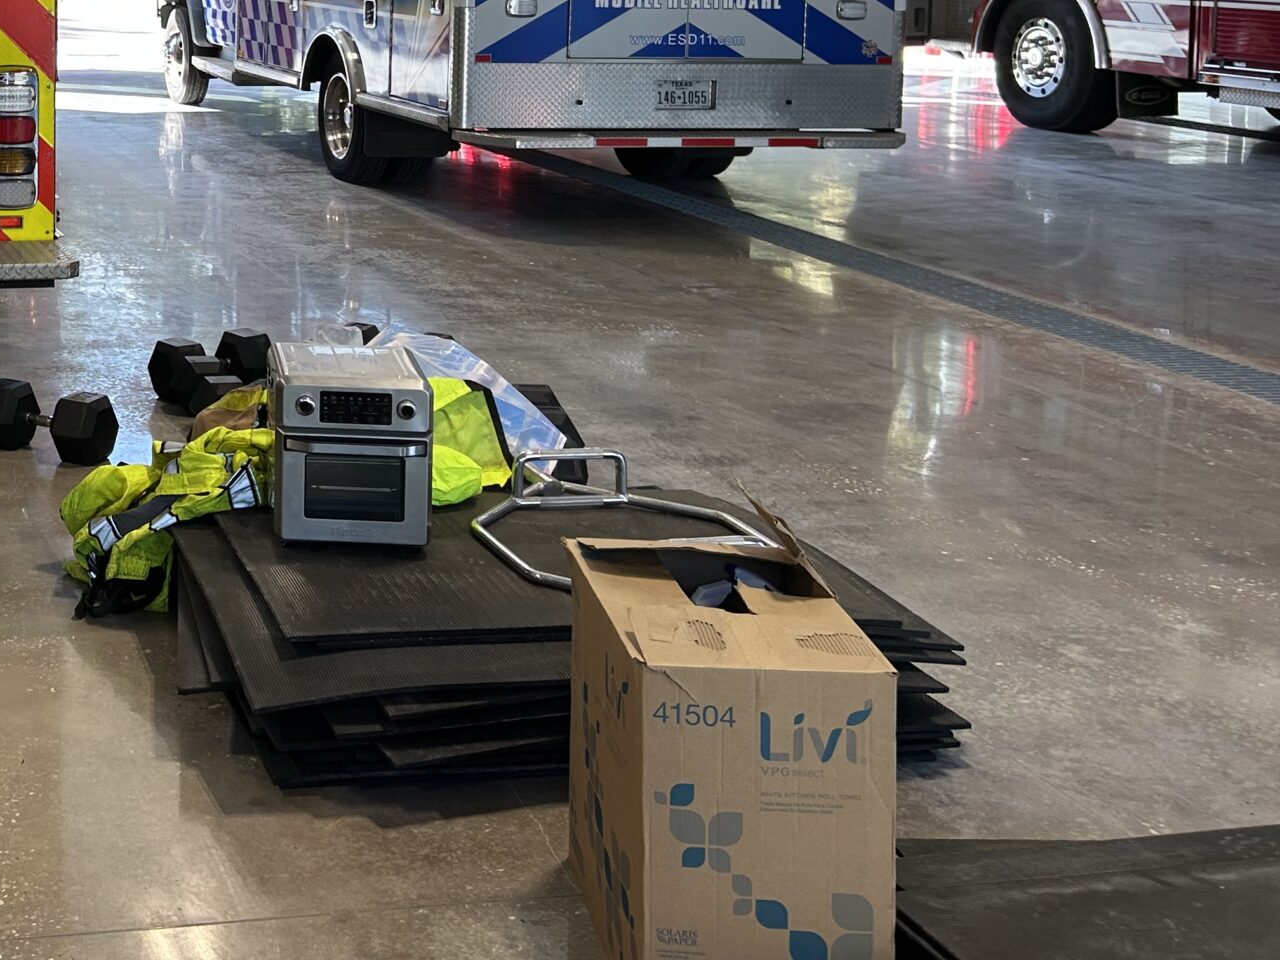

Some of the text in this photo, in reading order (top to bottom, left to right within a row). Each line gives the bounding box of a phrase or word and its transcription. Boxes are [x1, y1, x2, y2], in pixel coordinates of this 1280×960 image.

[629, 33, 746, 46] www.ESD11.com
[652, 702, 736, 728] 41504
[760, 698, 873, 764] Livi
[760, 766, 824, 778] VPG select
[784, 792, 816, 800] KITCHEN
[656, 928, 699, 938] SOLARIS
[667, 936, 699, 946] PAPER
